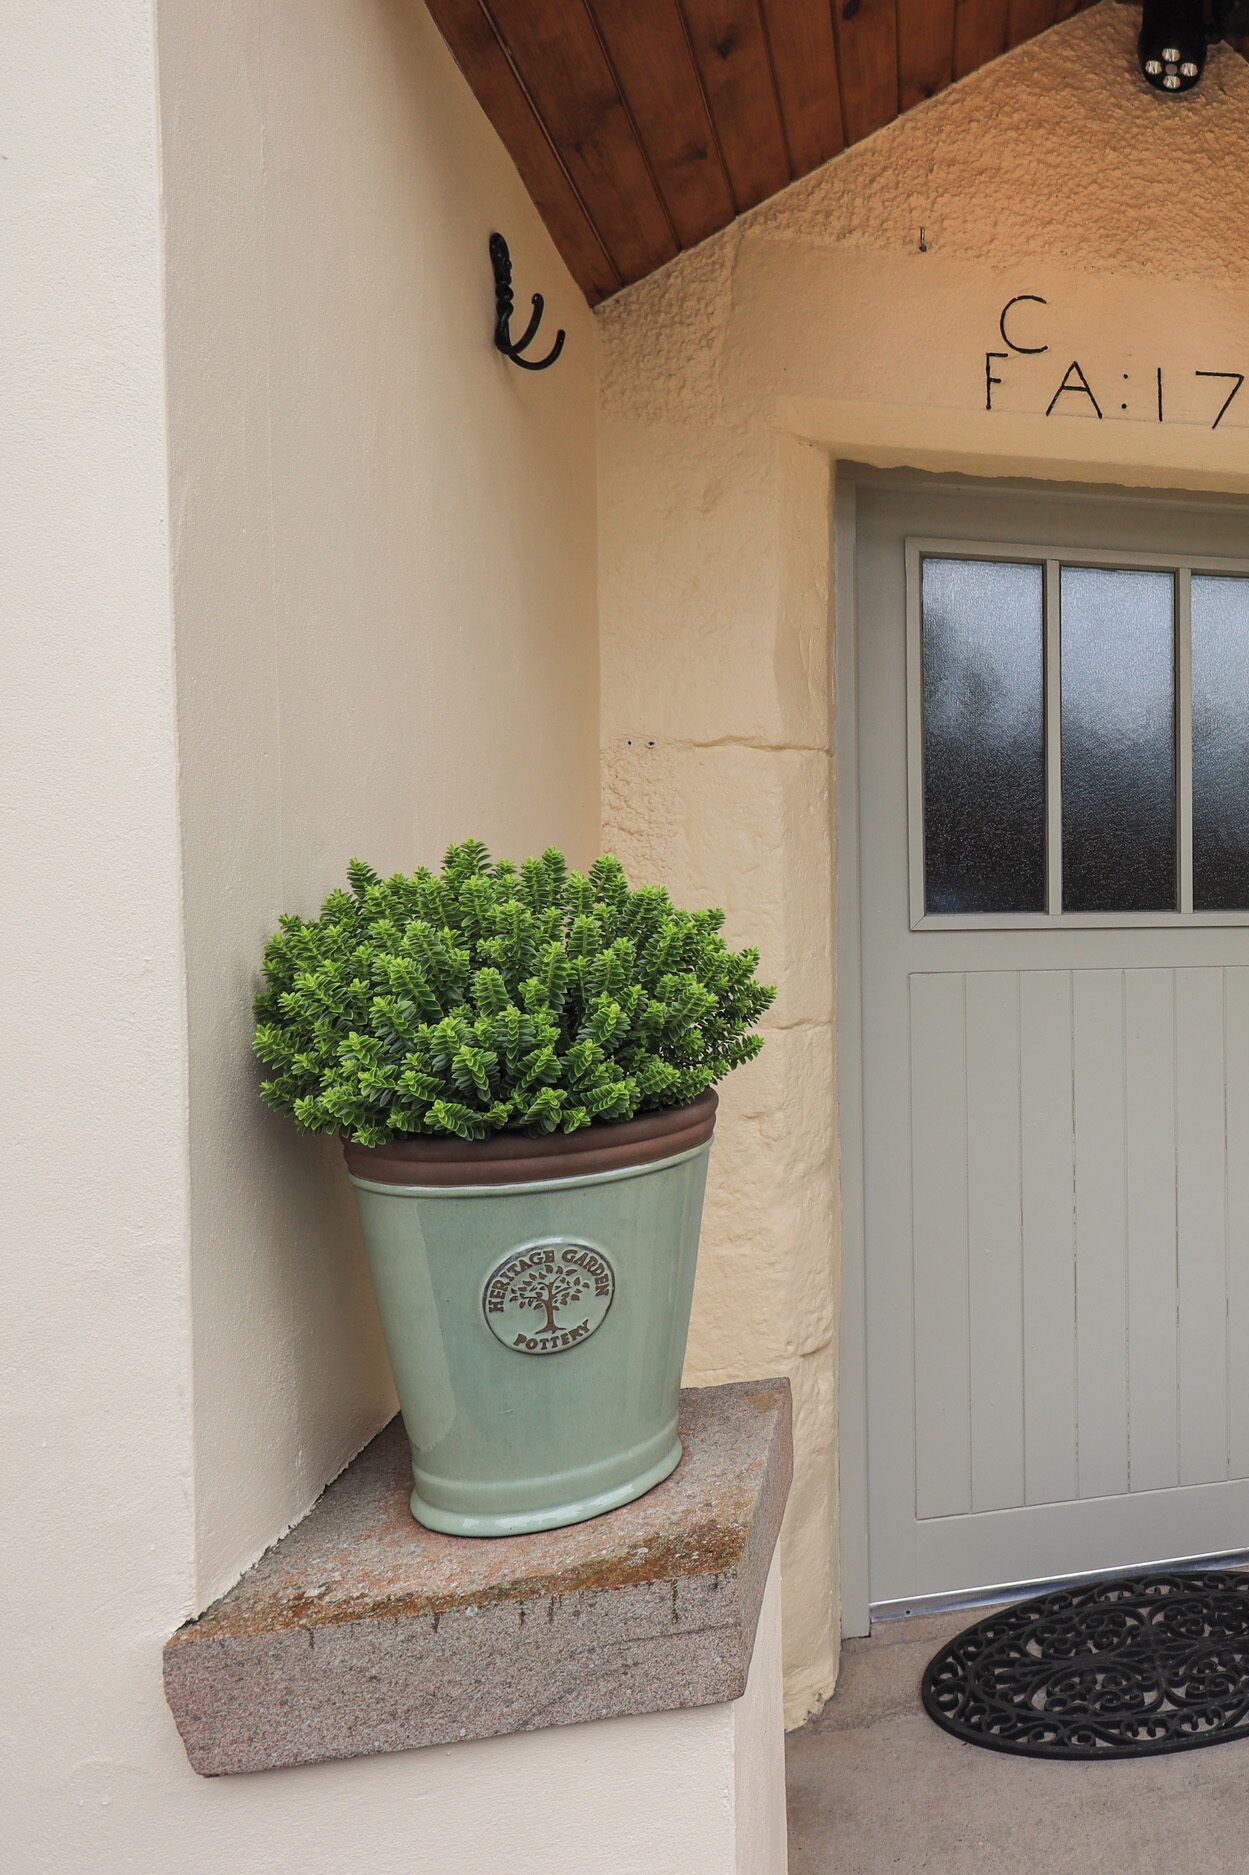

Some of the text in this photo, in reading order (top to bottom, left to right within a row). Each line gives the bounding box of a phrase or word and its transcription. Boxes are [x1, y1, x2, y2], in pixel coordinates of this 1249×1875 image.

[1000, 294, 1049, 354] C
[488, 1249, 610, 1313] HERITAGE GARDEN
[513, 1318, 590, 1350] POTTERY
